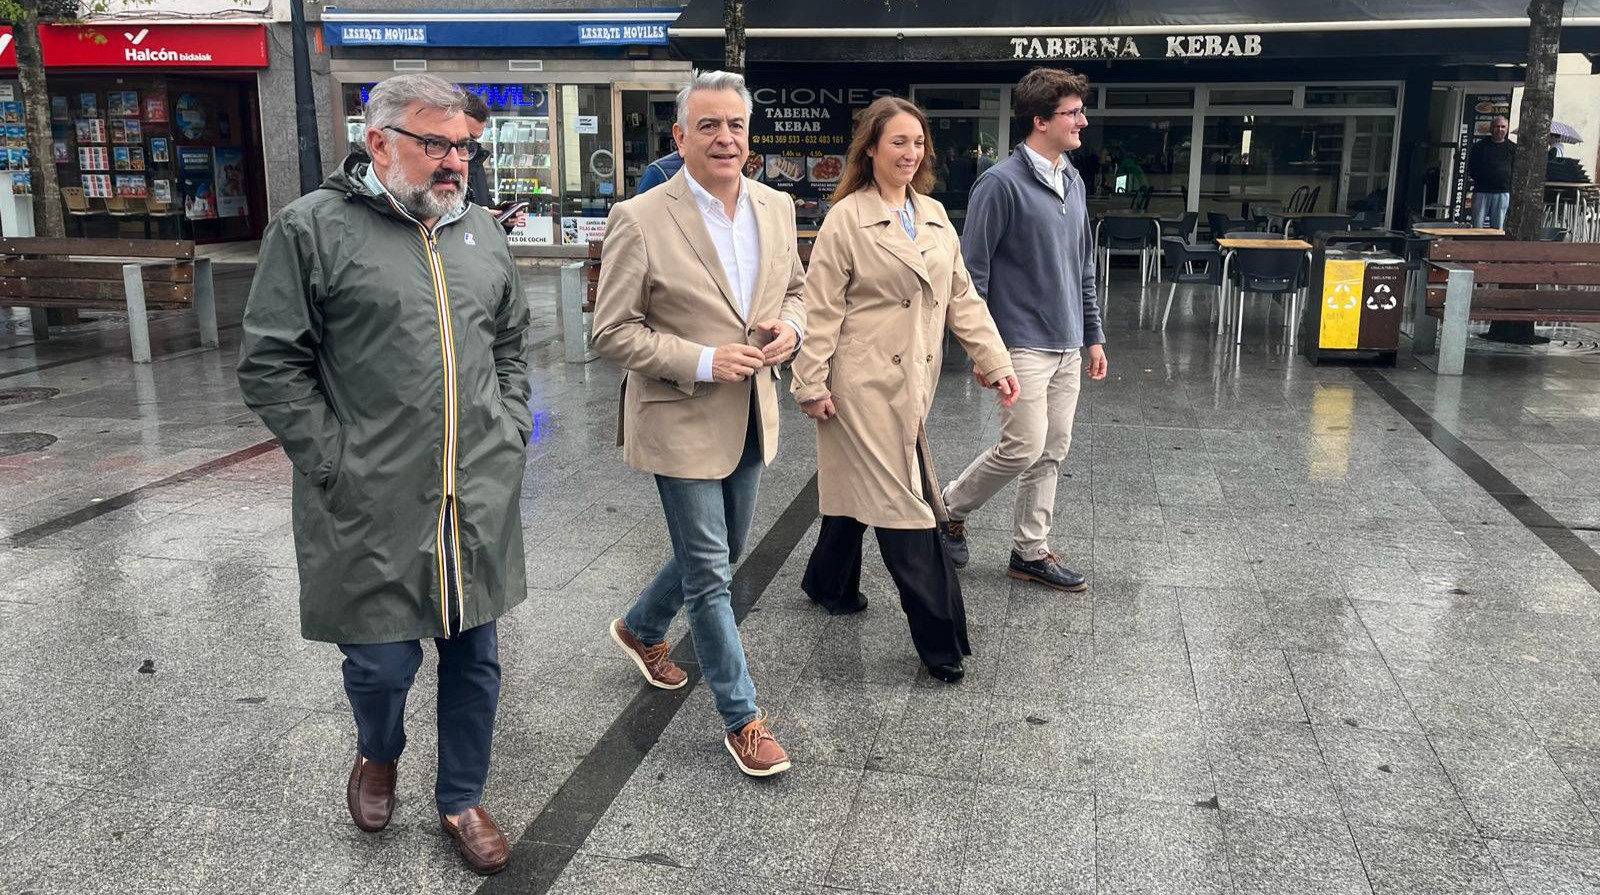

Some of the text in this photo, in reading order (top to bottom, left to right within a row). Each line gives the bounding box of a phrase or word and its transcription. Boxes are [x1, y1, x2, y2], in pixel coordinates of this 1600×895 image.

[1010, 34, 1262, 58] TABERNA KEBAB
[124, 47, 212, 61] Halcón bidaiak
[753, 88, 897, 104] CIONES
[765, 108, 830, 119] TABERNA
[774, 121, 821, 132] KEBAB
[761, 135, 774, 144] 943
[788, 135, 800, 144] 533
[805, 135, 817, 144] 632
[832, 135, 844, 144] 161
